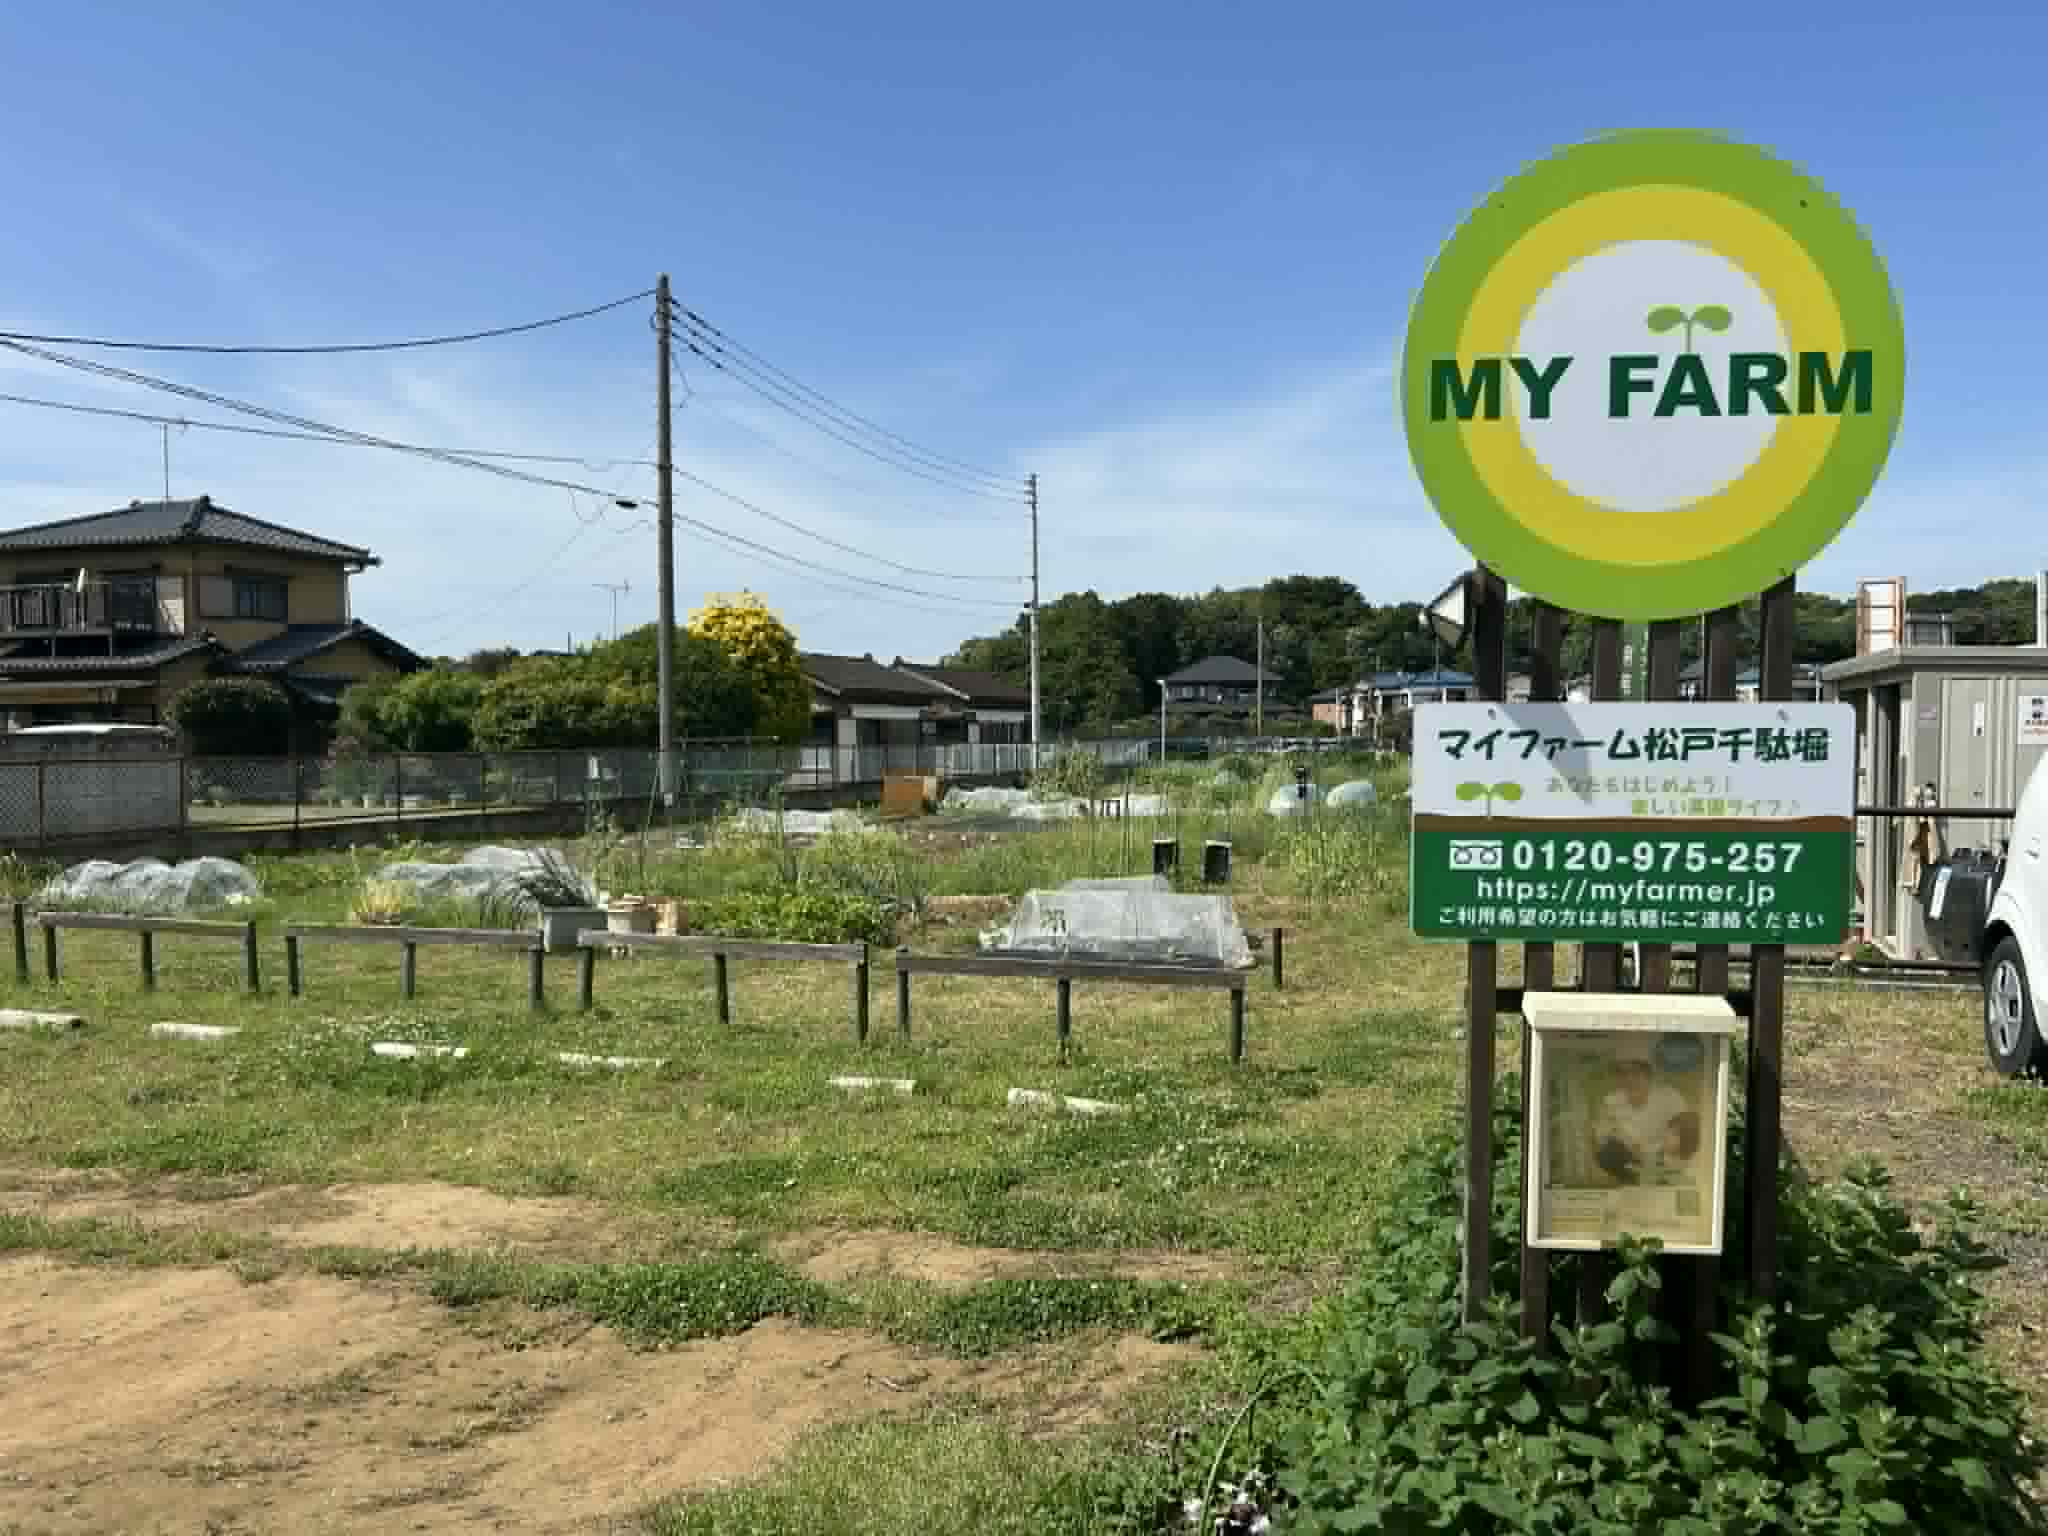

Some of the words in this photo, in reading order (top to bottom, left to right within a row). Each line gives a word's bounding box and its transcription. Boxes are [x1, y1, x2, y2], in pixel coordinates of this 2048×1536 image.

[1431, 355, 1573, 421] MY
[1608, 351, 1873, 418] FARM
[1438, 729, 1829, 761] マイファーム松戸千駄堀
[1512, 842, 1803, 872] 0120-975-257
[1477, 879, 1775, 904] https://myfarmer.jp
